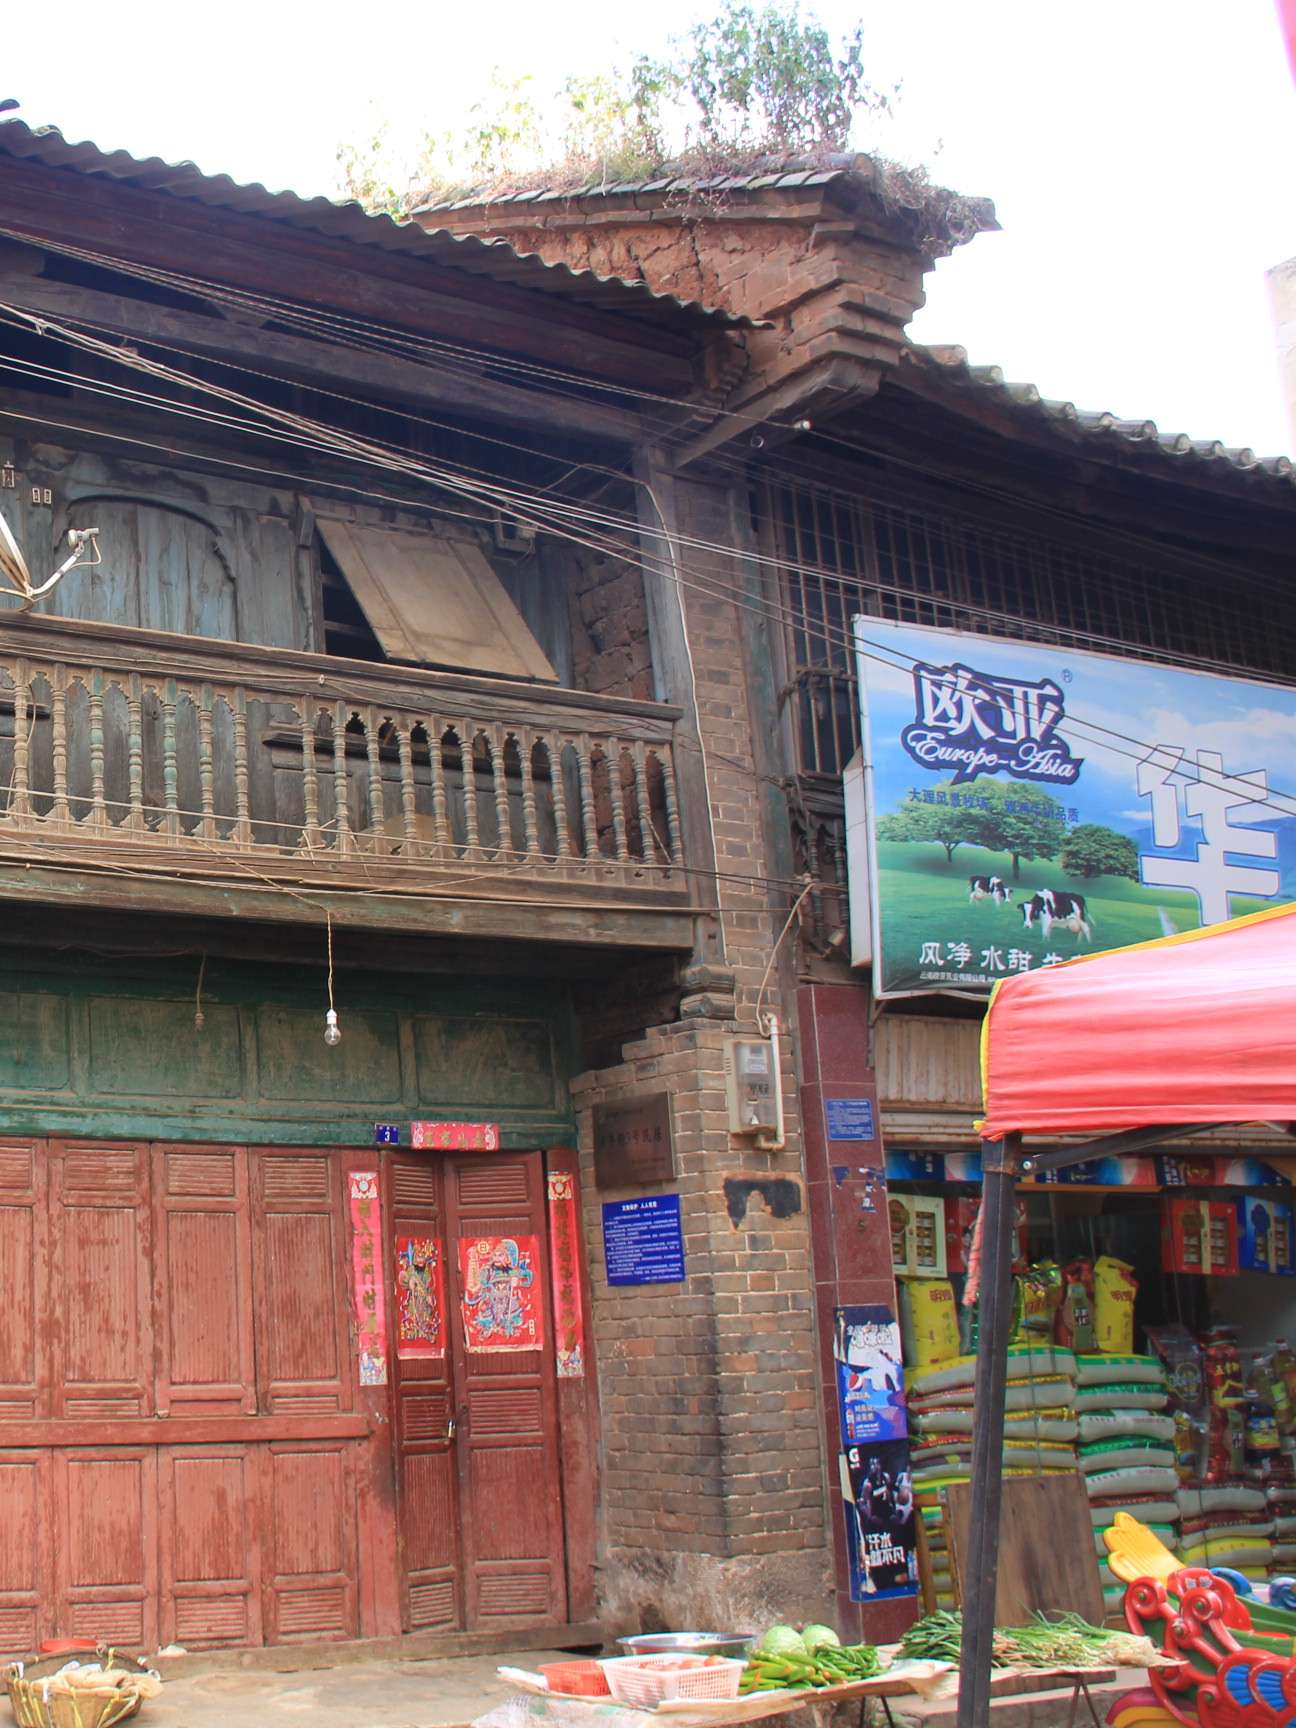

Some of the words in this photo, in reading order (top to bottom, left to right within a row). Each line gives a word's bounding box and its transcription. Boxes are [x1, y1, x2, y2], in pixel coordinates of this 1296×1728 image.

[919, 669, 1059, 745] 欧亚
[919, 942, 972, 969] 风净
[981, 945, 1032, 972] 水甜
[384, 1131, 391, 1142] 3
